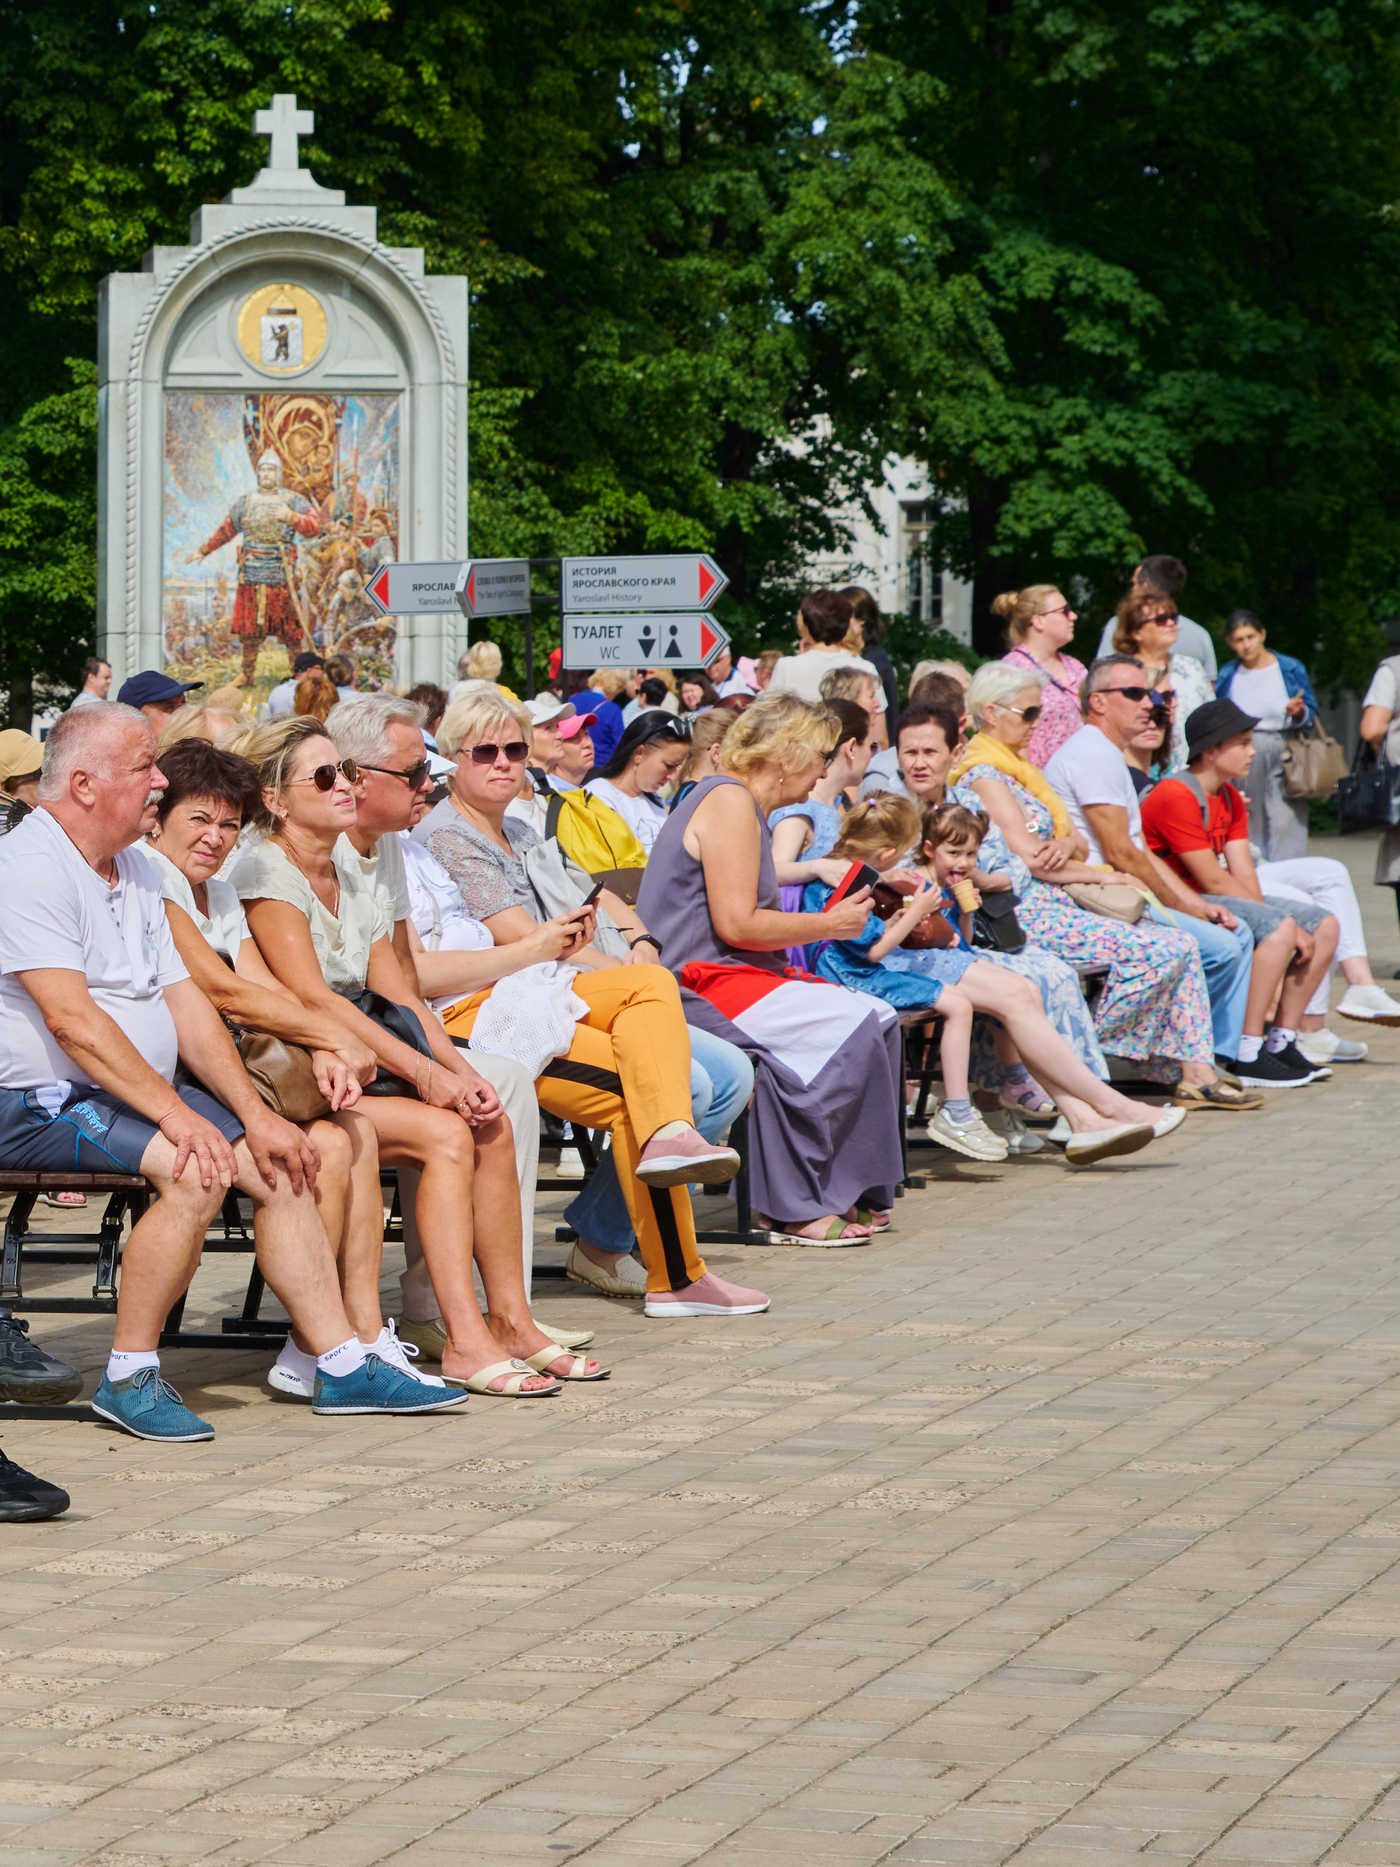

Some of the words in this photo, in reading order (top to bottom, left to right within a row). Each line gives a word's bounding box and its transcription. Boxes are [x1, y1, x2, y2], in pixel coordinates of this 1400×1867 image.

[572, 566, 617, 577] ИСТОРИЯ
[572, 578, 649, 589] ЯРОСЛАВСКОГО
[651, 577, 676, 586] КРАЯ
[611, 592, 642, 603] History
[572, 625, 623, 639] ТУАЛЕТ
[600, 646, 621, 660] WC
